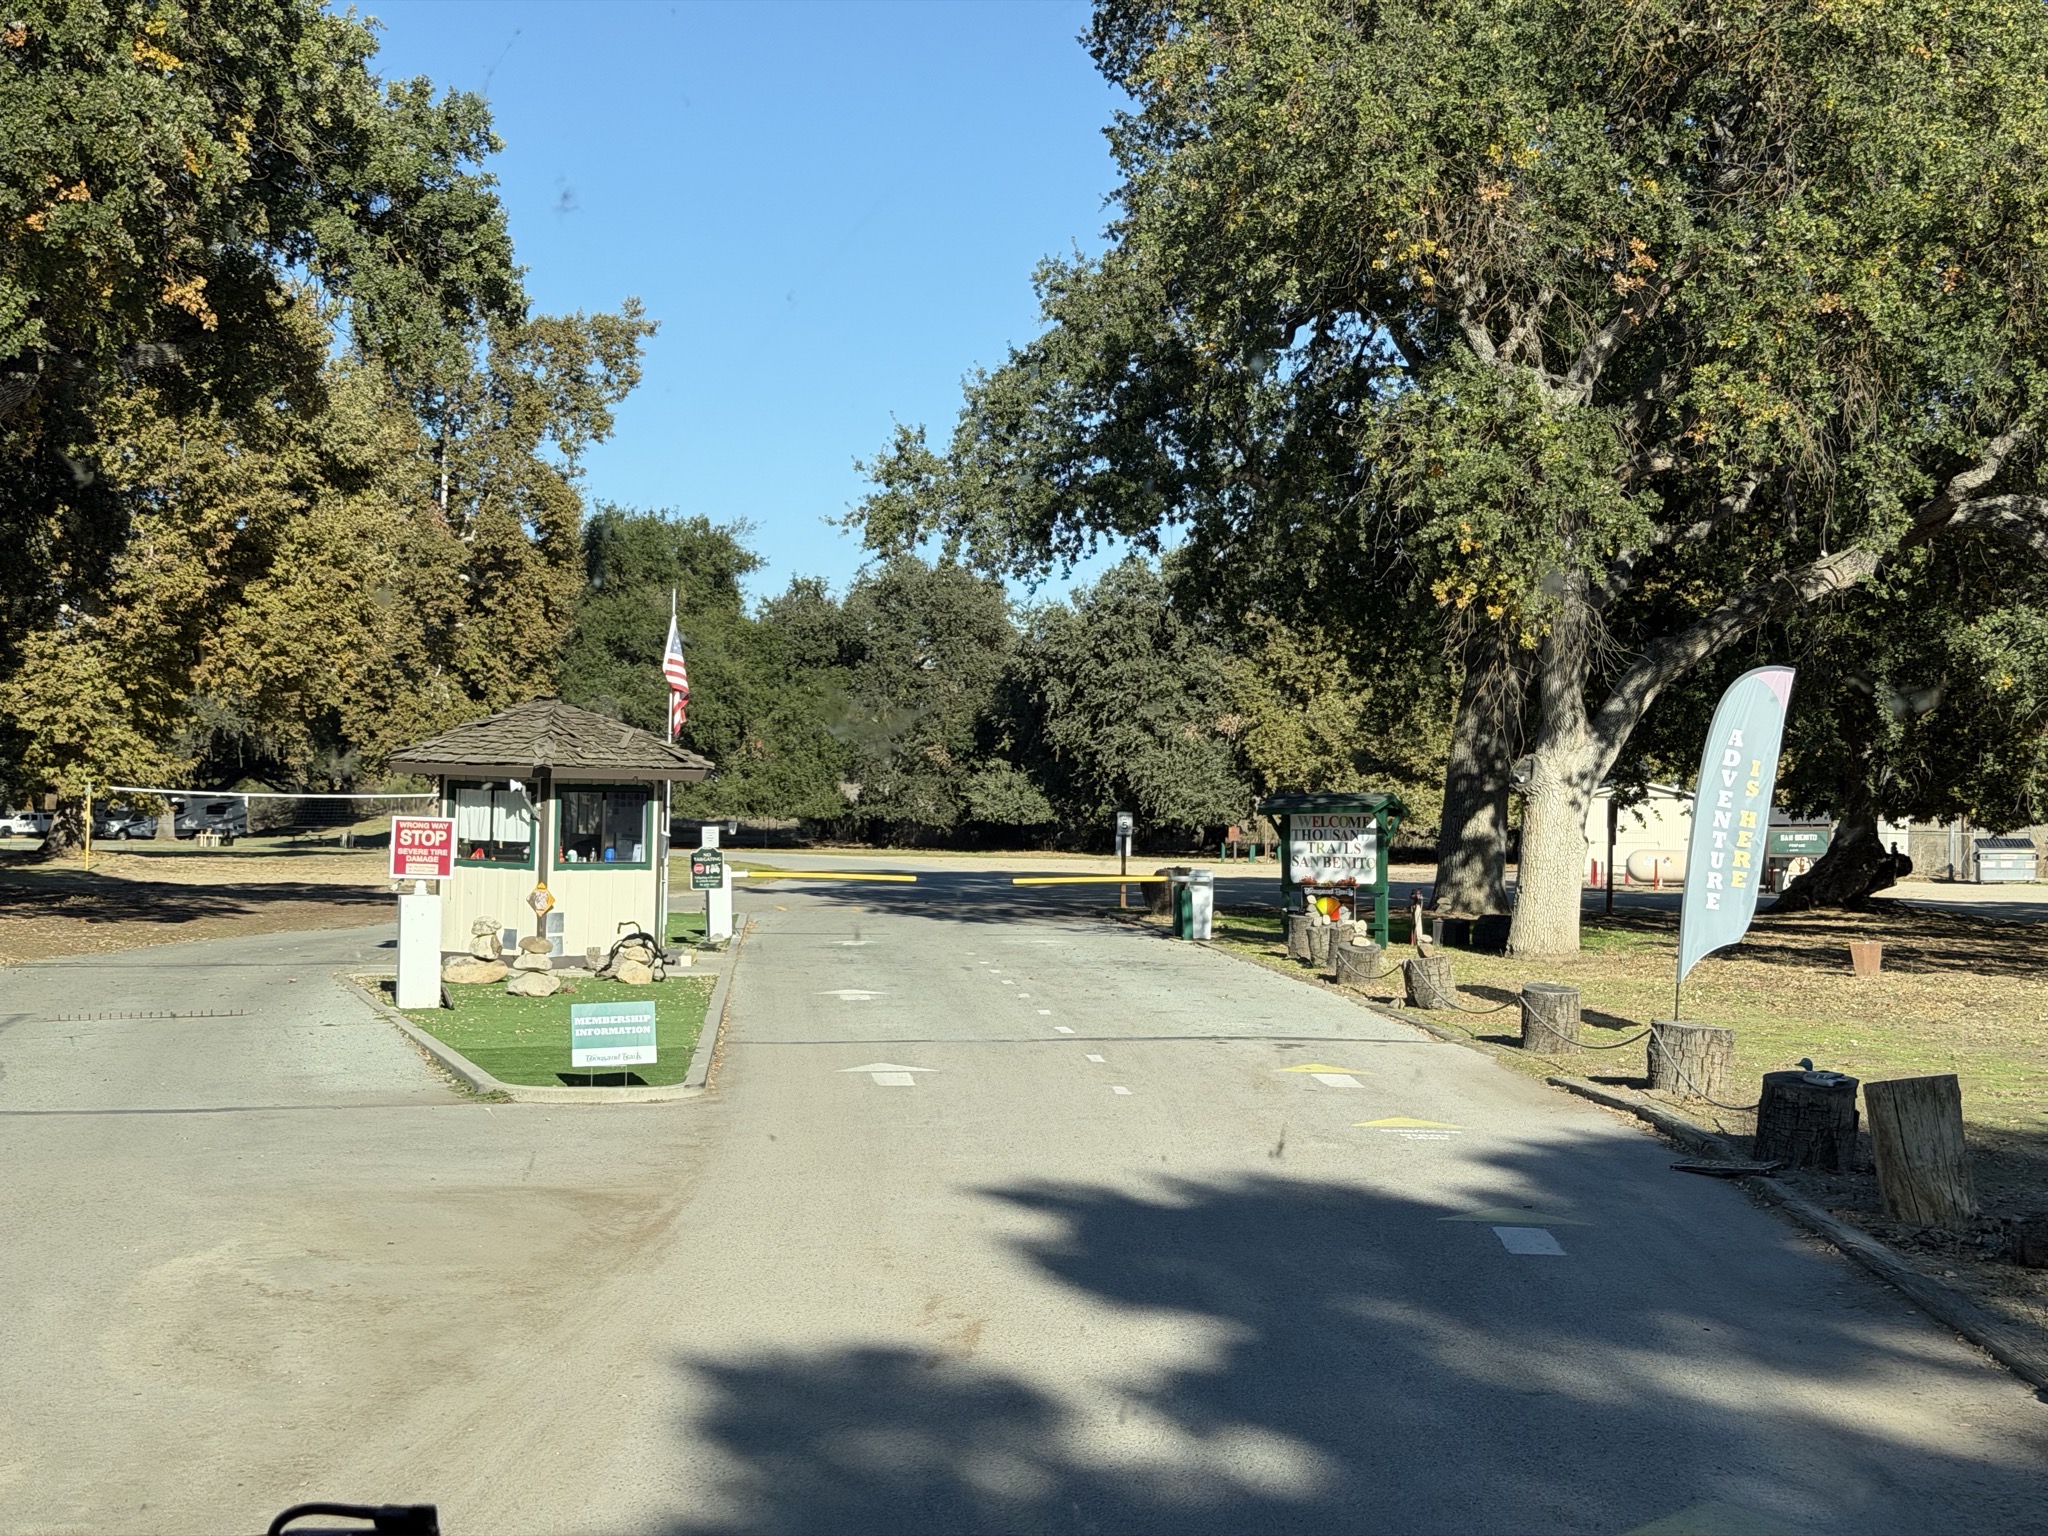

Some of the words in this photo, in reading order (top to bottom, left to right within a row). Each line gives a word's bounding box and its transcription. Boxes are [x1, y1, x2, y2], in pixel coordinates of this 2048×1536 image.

[1746, 760, 1761, 798] IS
[399, 821, 430, 829] WRONG
[431, 822, 449, 830] WAY
[1121, 821, 1129, 830] 5
[1297, 815, 1371, 828] WELCOME
[1706, 729, 1743, 910] ADVENTURE
[399, 829, 448, 847] STOP
[1292, 828, 1370, 842] THOUSAND
[1780, 834, 1794, 842] SAN
[1794, 833, 1818, 842] BENITO
[397, 847, 430, 856] SEVERE
[430, 848, 449, 857] TIRE
[1307, 841, 1362, 855] TRAILS
[1731, 810, 1757, 888] HERE
[405, 855, 440, 863] DAMAGE
[1291, 855, 1320, 868] SAN
[1323, 856, 1377, 870] BENITO
[573, 1014, 652, 1026] MEMBERSHIP
[574, 1025, 652, 1037] INFORMATION
